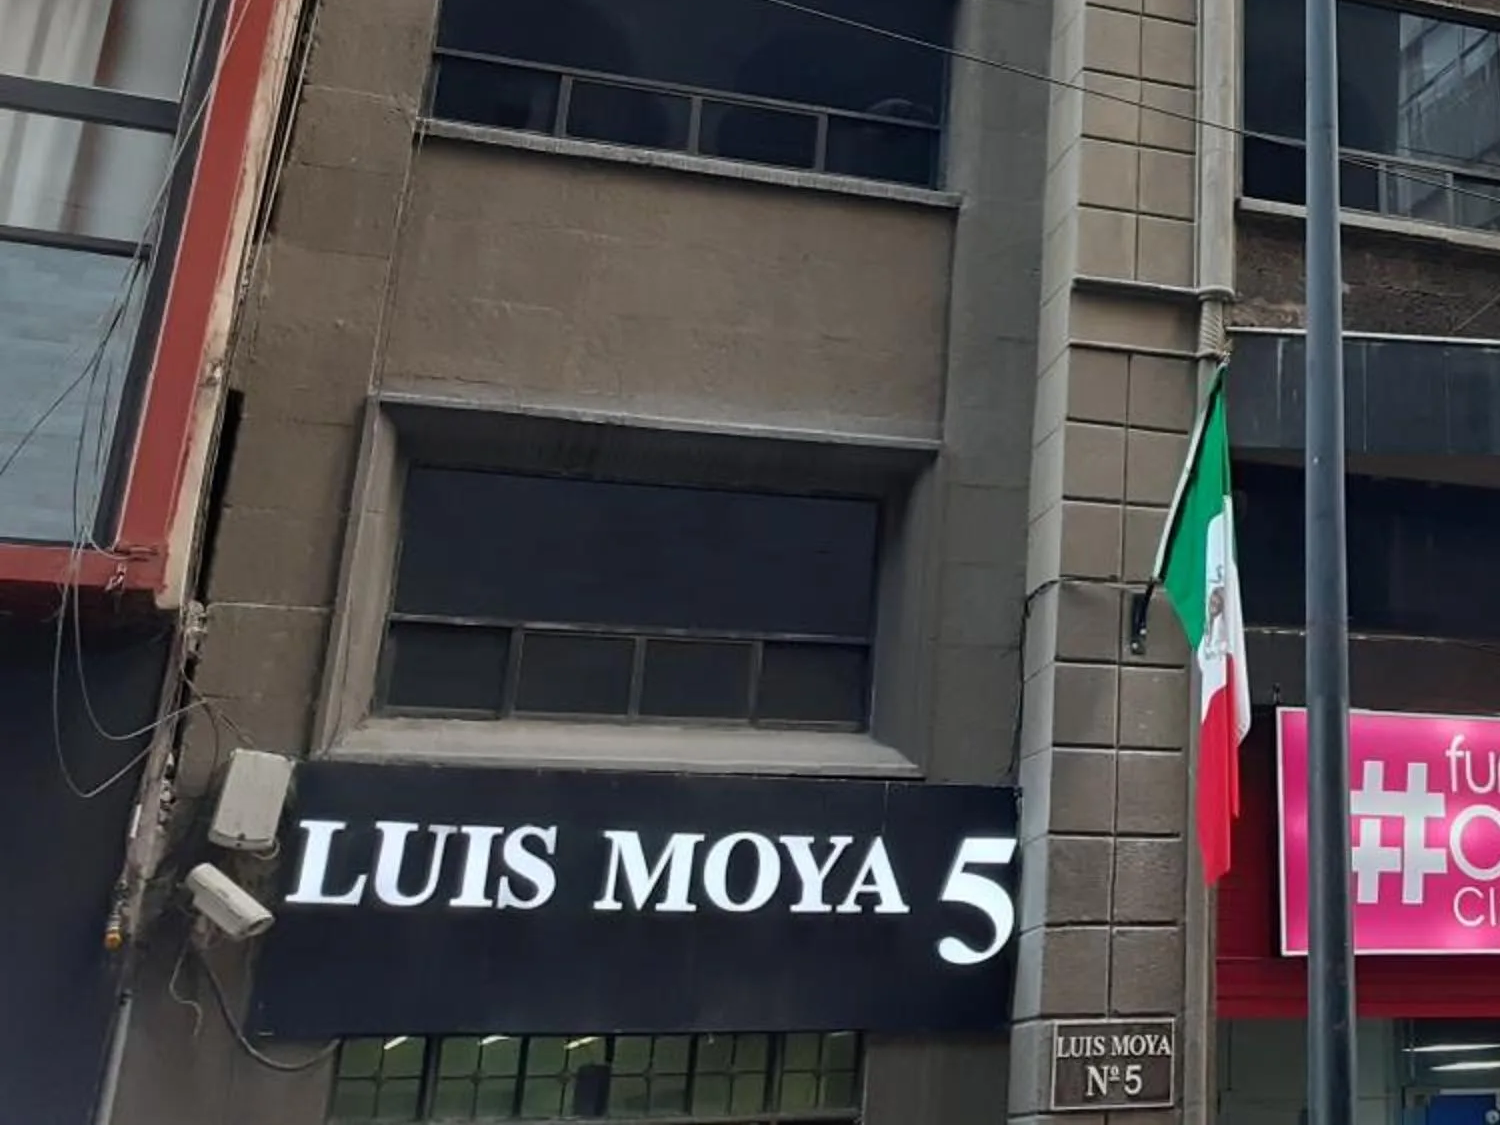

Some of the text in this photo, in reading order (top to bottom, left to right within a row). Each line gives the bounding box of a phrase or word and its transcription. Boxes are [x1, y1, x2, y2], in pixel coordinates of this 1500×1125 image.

[284, 819, 1018, 966] LUIS MOYA 5
[1056, 1033, 1172, 1059] LUIS MOYA
[1123, 1064, 1143, 1095] 5
